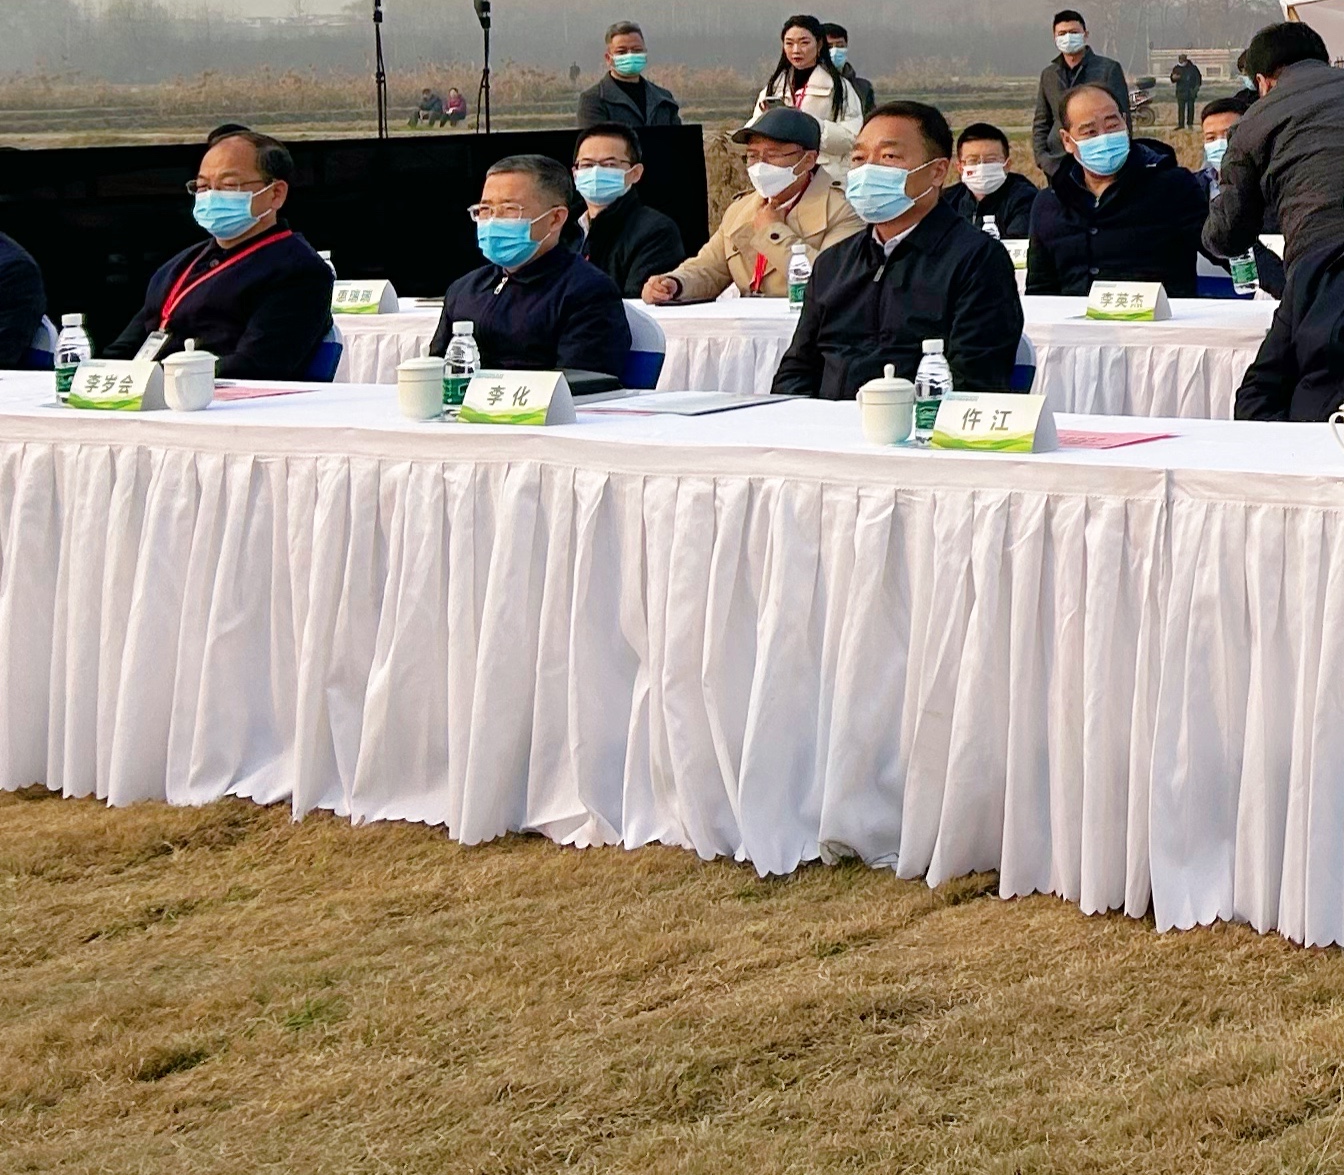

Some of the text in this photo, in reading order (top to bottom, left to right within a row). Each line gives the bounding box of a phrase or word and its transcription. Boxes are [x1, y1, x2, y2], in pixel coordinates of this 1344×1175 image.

[1100, 291, 1145, 309] 李英杰
[84, 373, 134, 395] 李岁会
[487, 384, 530, 406] 李化
